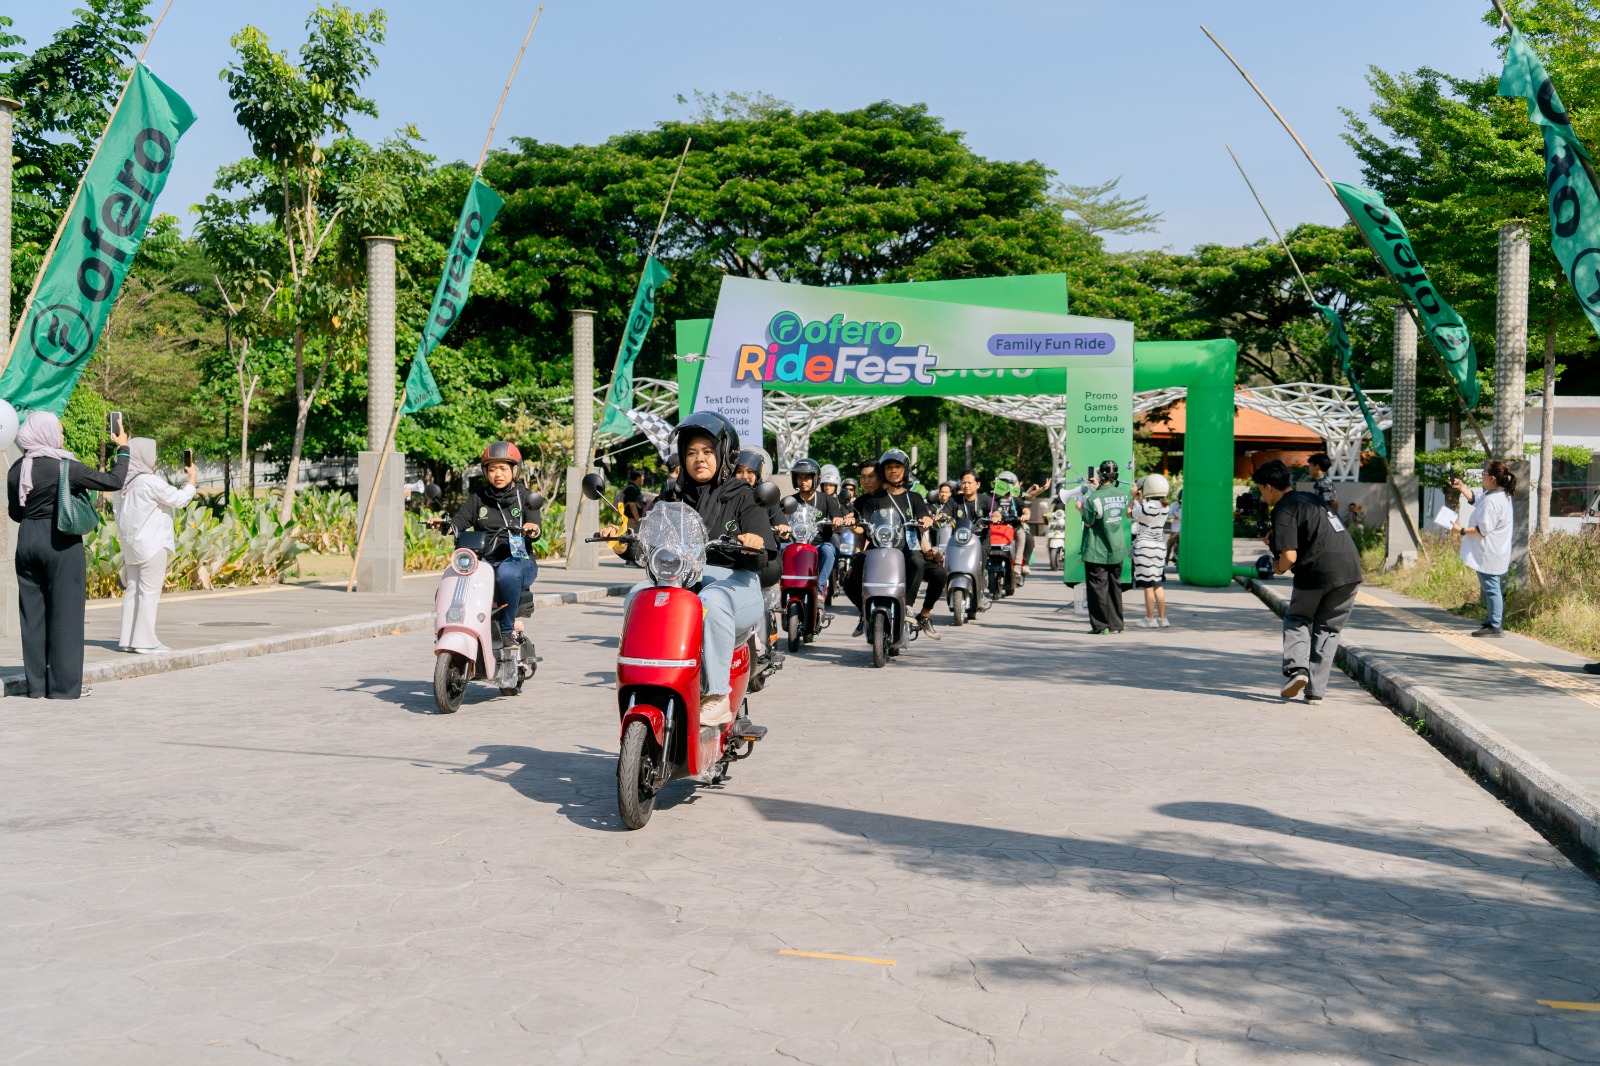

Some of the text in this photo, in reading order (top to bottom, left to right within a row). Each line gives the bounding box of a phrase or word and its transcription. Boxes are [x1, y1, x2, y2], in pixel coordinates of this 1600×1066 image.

[77, 127, 171, 302] ofero
[1364, 203, 1440, 315] ofero
[804, 314, 902, 345] ofero
[996, 337, 1106, 353] Family Fun Ride
[704, 395, 750, 404] Test Drive
[1085, 391, 1118, 400] Promo
[717, 407, 750, 415] Konvoi
[1084, 403, 1119, 411] Games
[729, 418, 750, 426] Ride
[1084, 414, 1118, 423] Lomba
[1077, 425, 1125, 435] Doorprize
